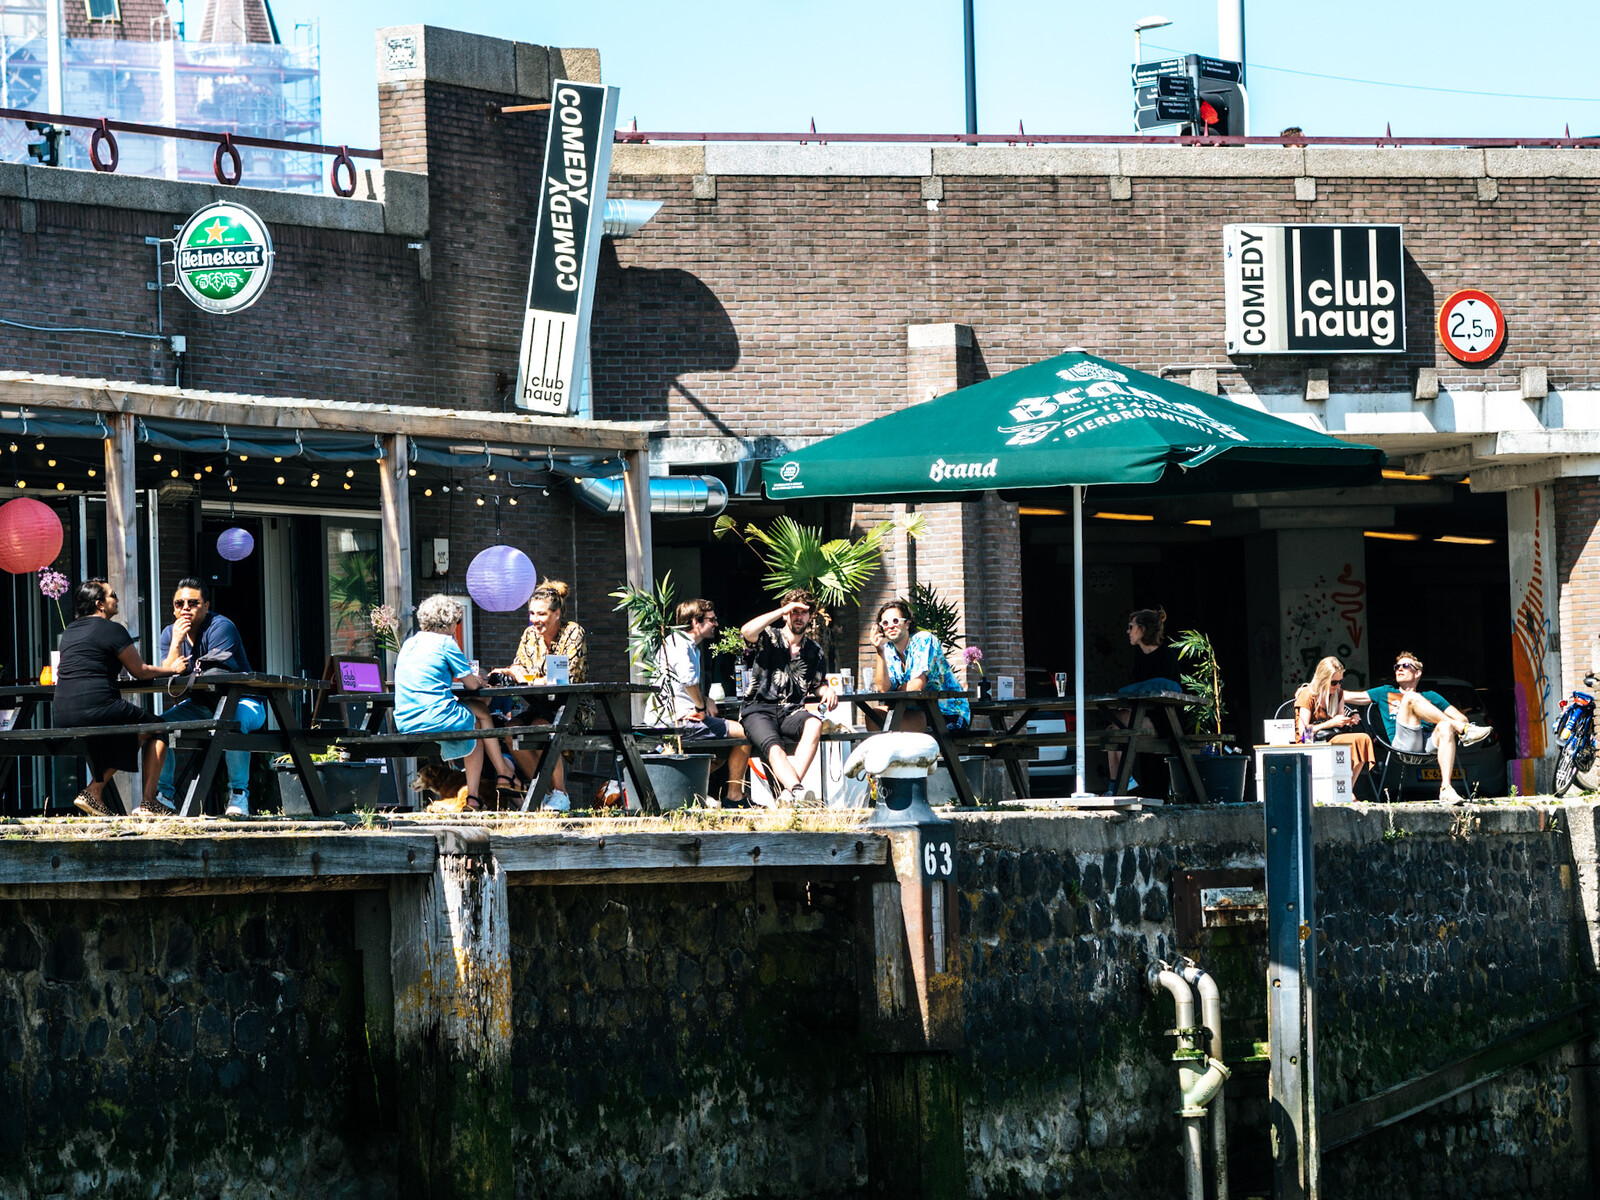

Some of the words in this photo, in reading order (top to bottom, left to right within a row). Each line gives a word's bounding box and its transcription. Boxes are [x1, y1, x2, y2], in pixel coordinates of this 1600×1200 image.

[558, 88, 589, 206] COMEDY
[181, 248, 260, 268] Heineken
[548, 176, 579, 292] COMEDY
[1308, 229, 1396, 307] club
[1240, 229, 1266, 346] COMEDY
[929, 458, 998, 483] Brand
[924, 841, 953, 876] 63
